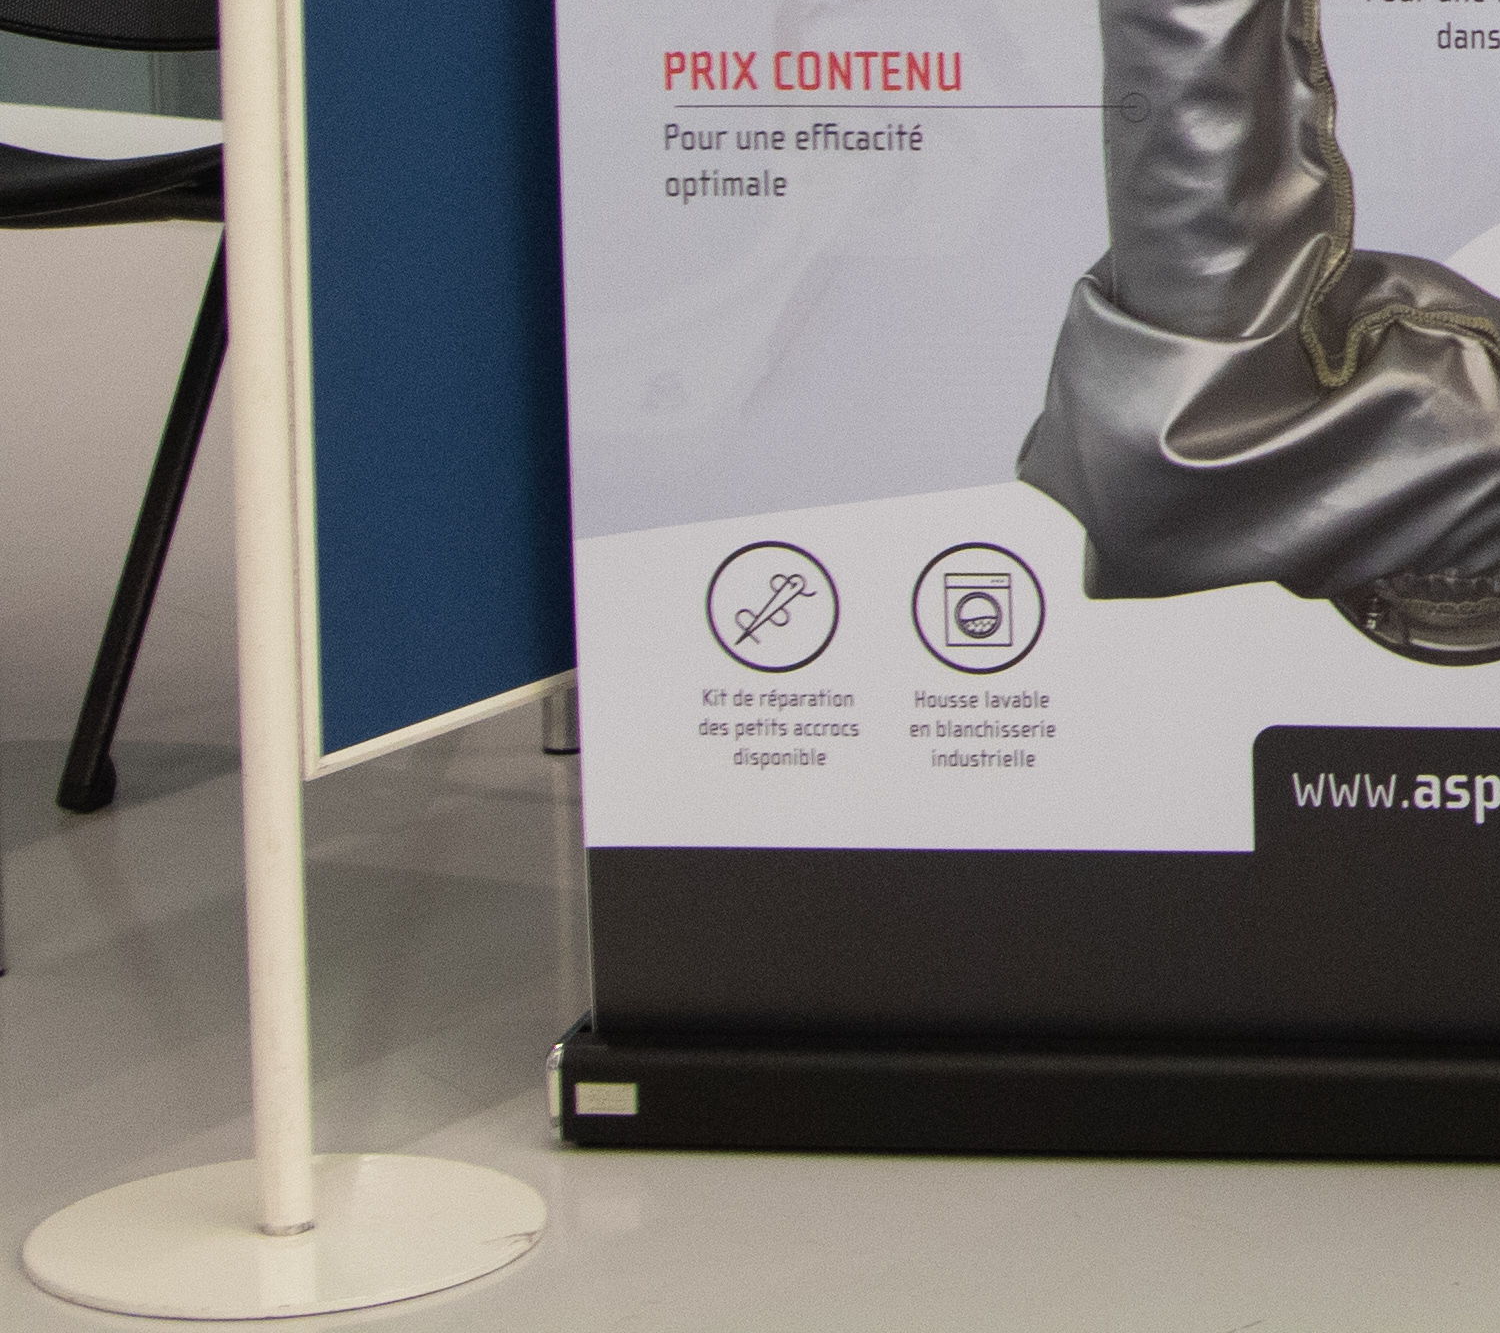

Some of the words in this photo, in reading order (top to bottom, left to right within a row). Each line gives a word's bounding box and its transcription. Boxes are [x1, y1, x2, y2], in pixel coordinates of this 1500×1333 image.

[1437, 22, 1500, 50] dans
[664, 51, 758, 92] PRIX
[773, 51, 963, 92] CONTENU
[664, 123, 727, 151] Pour
[736, 129, 786, 151] une
[795, 123, 924, 152] efficacité
[664, 170, 788, 205] optimale
[701, 689, 728, 708] Kit
[733, 689, 754, 708] de
[758, 689, 856, 712] réparation
[913, 690, 979, 709] Housse
[984, 690, 1051, 709] lavable
[698, 718, 729, 736] des
[734, 718, 787, 740] petits
[793, 722, 860, 737] accrocs
[909, 723, 931, 738] en
[936, 719, 1057, 739] blanchisserie
[733, 748, 827, 771] disponible
[931, 749, 1037, 768] industrielle
